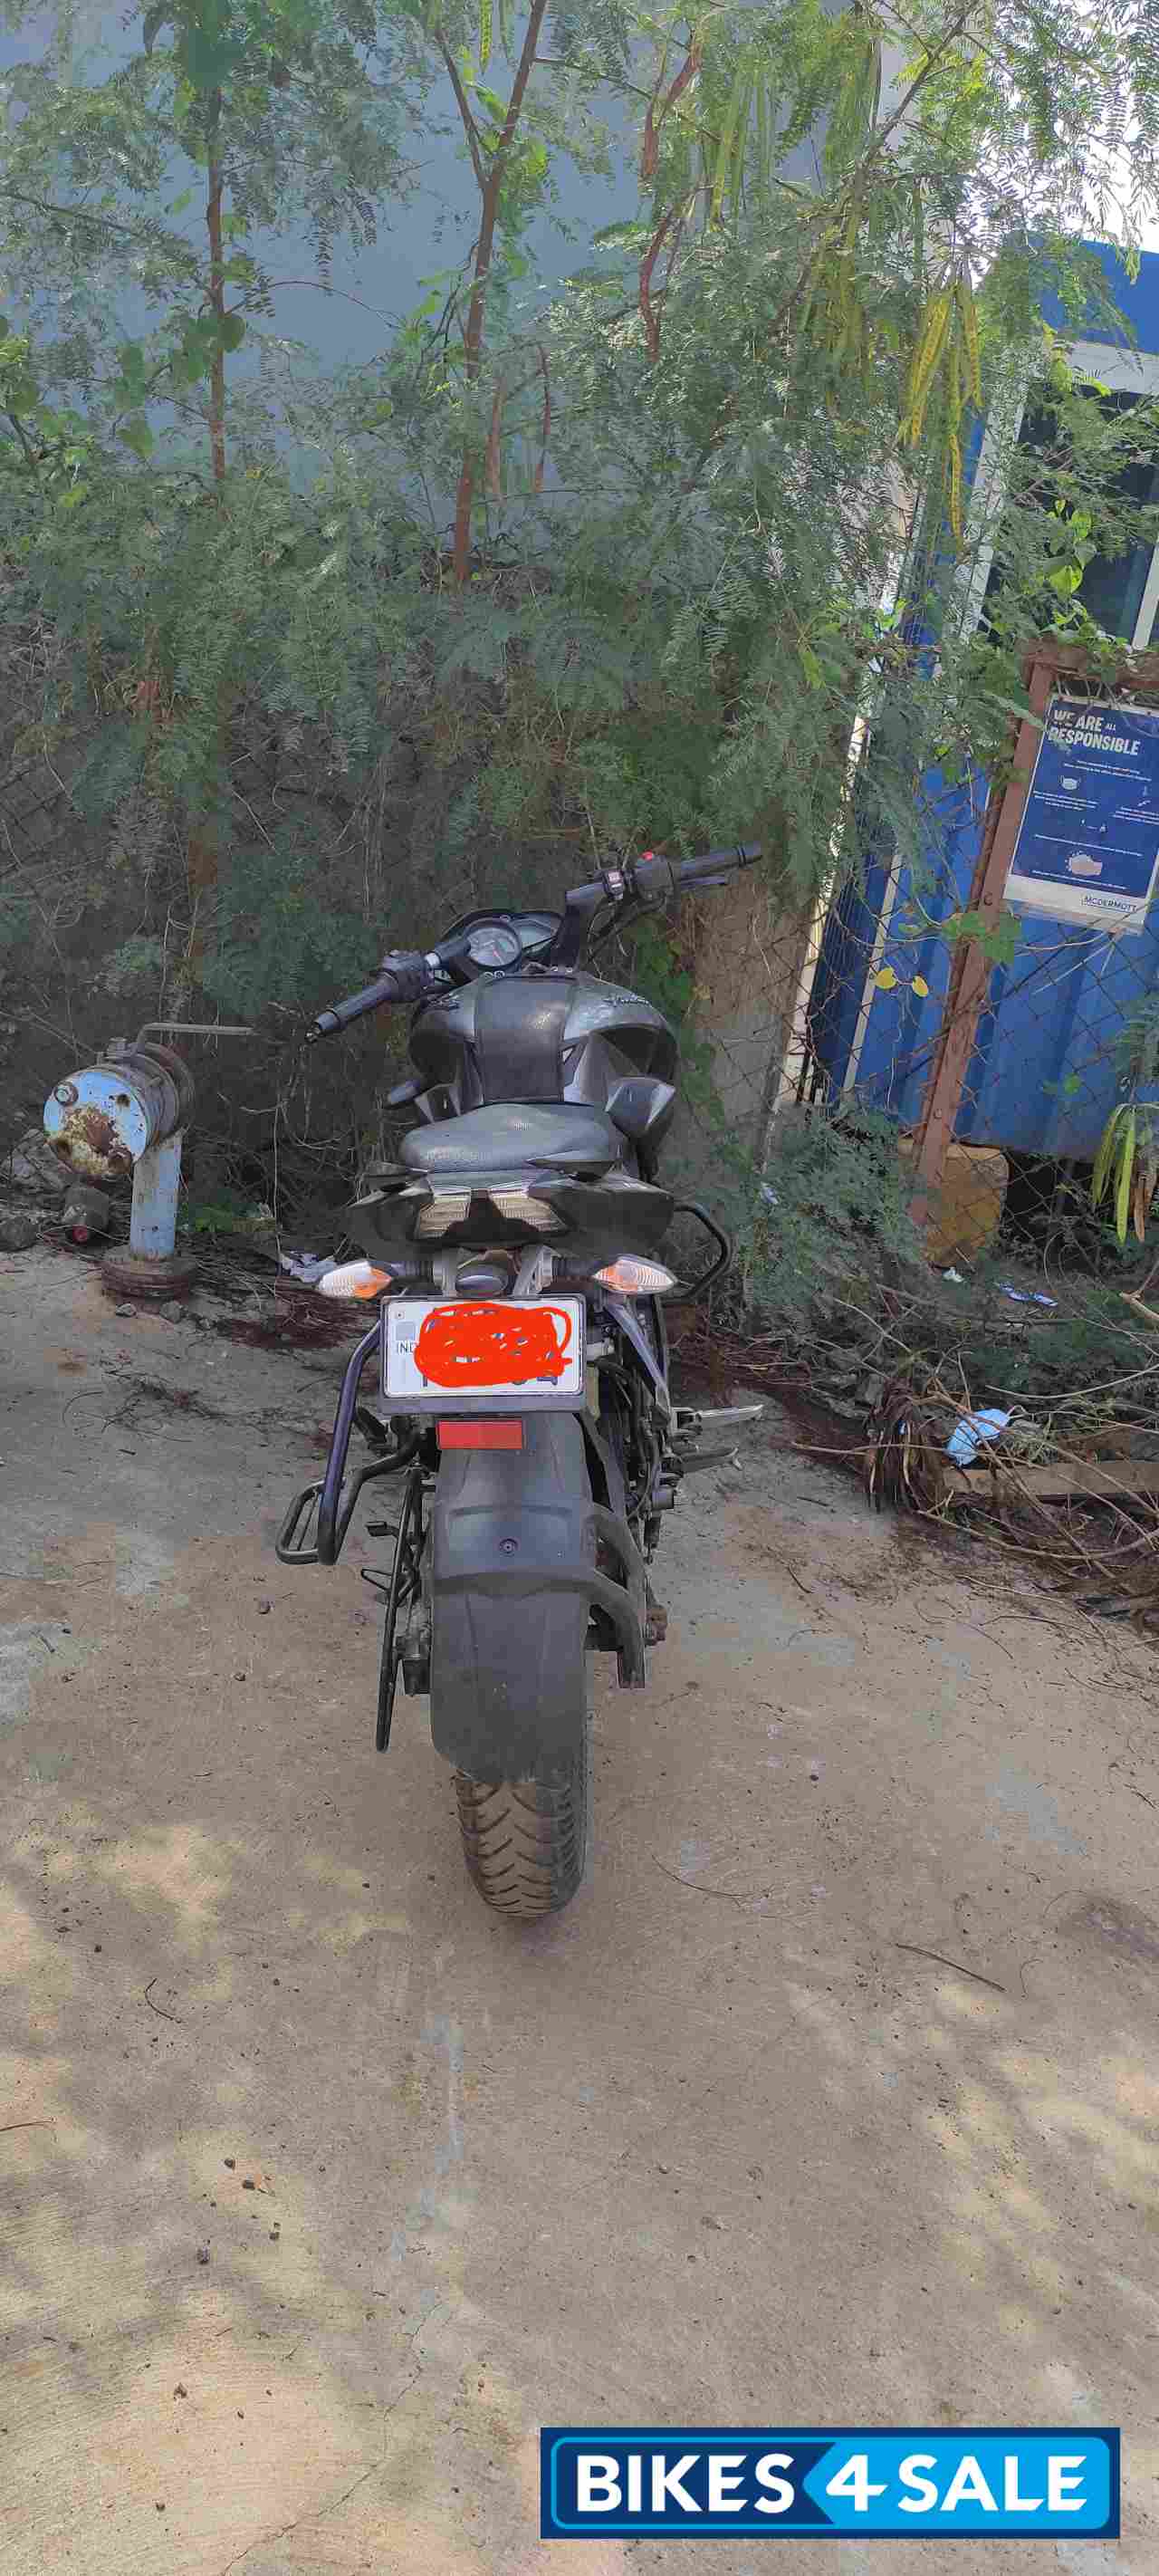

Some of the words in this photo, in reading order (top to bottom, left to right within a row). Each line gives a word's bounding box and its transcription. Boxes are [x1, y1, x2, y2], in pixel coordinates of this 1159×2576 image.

[1053, 710, 1075, 726] WE
[1075, 716, 1104, 732] ARE
[1105, 723, 1116, 731] ALL
[1048, 726, 1141, 755] RESPONSIBLE
